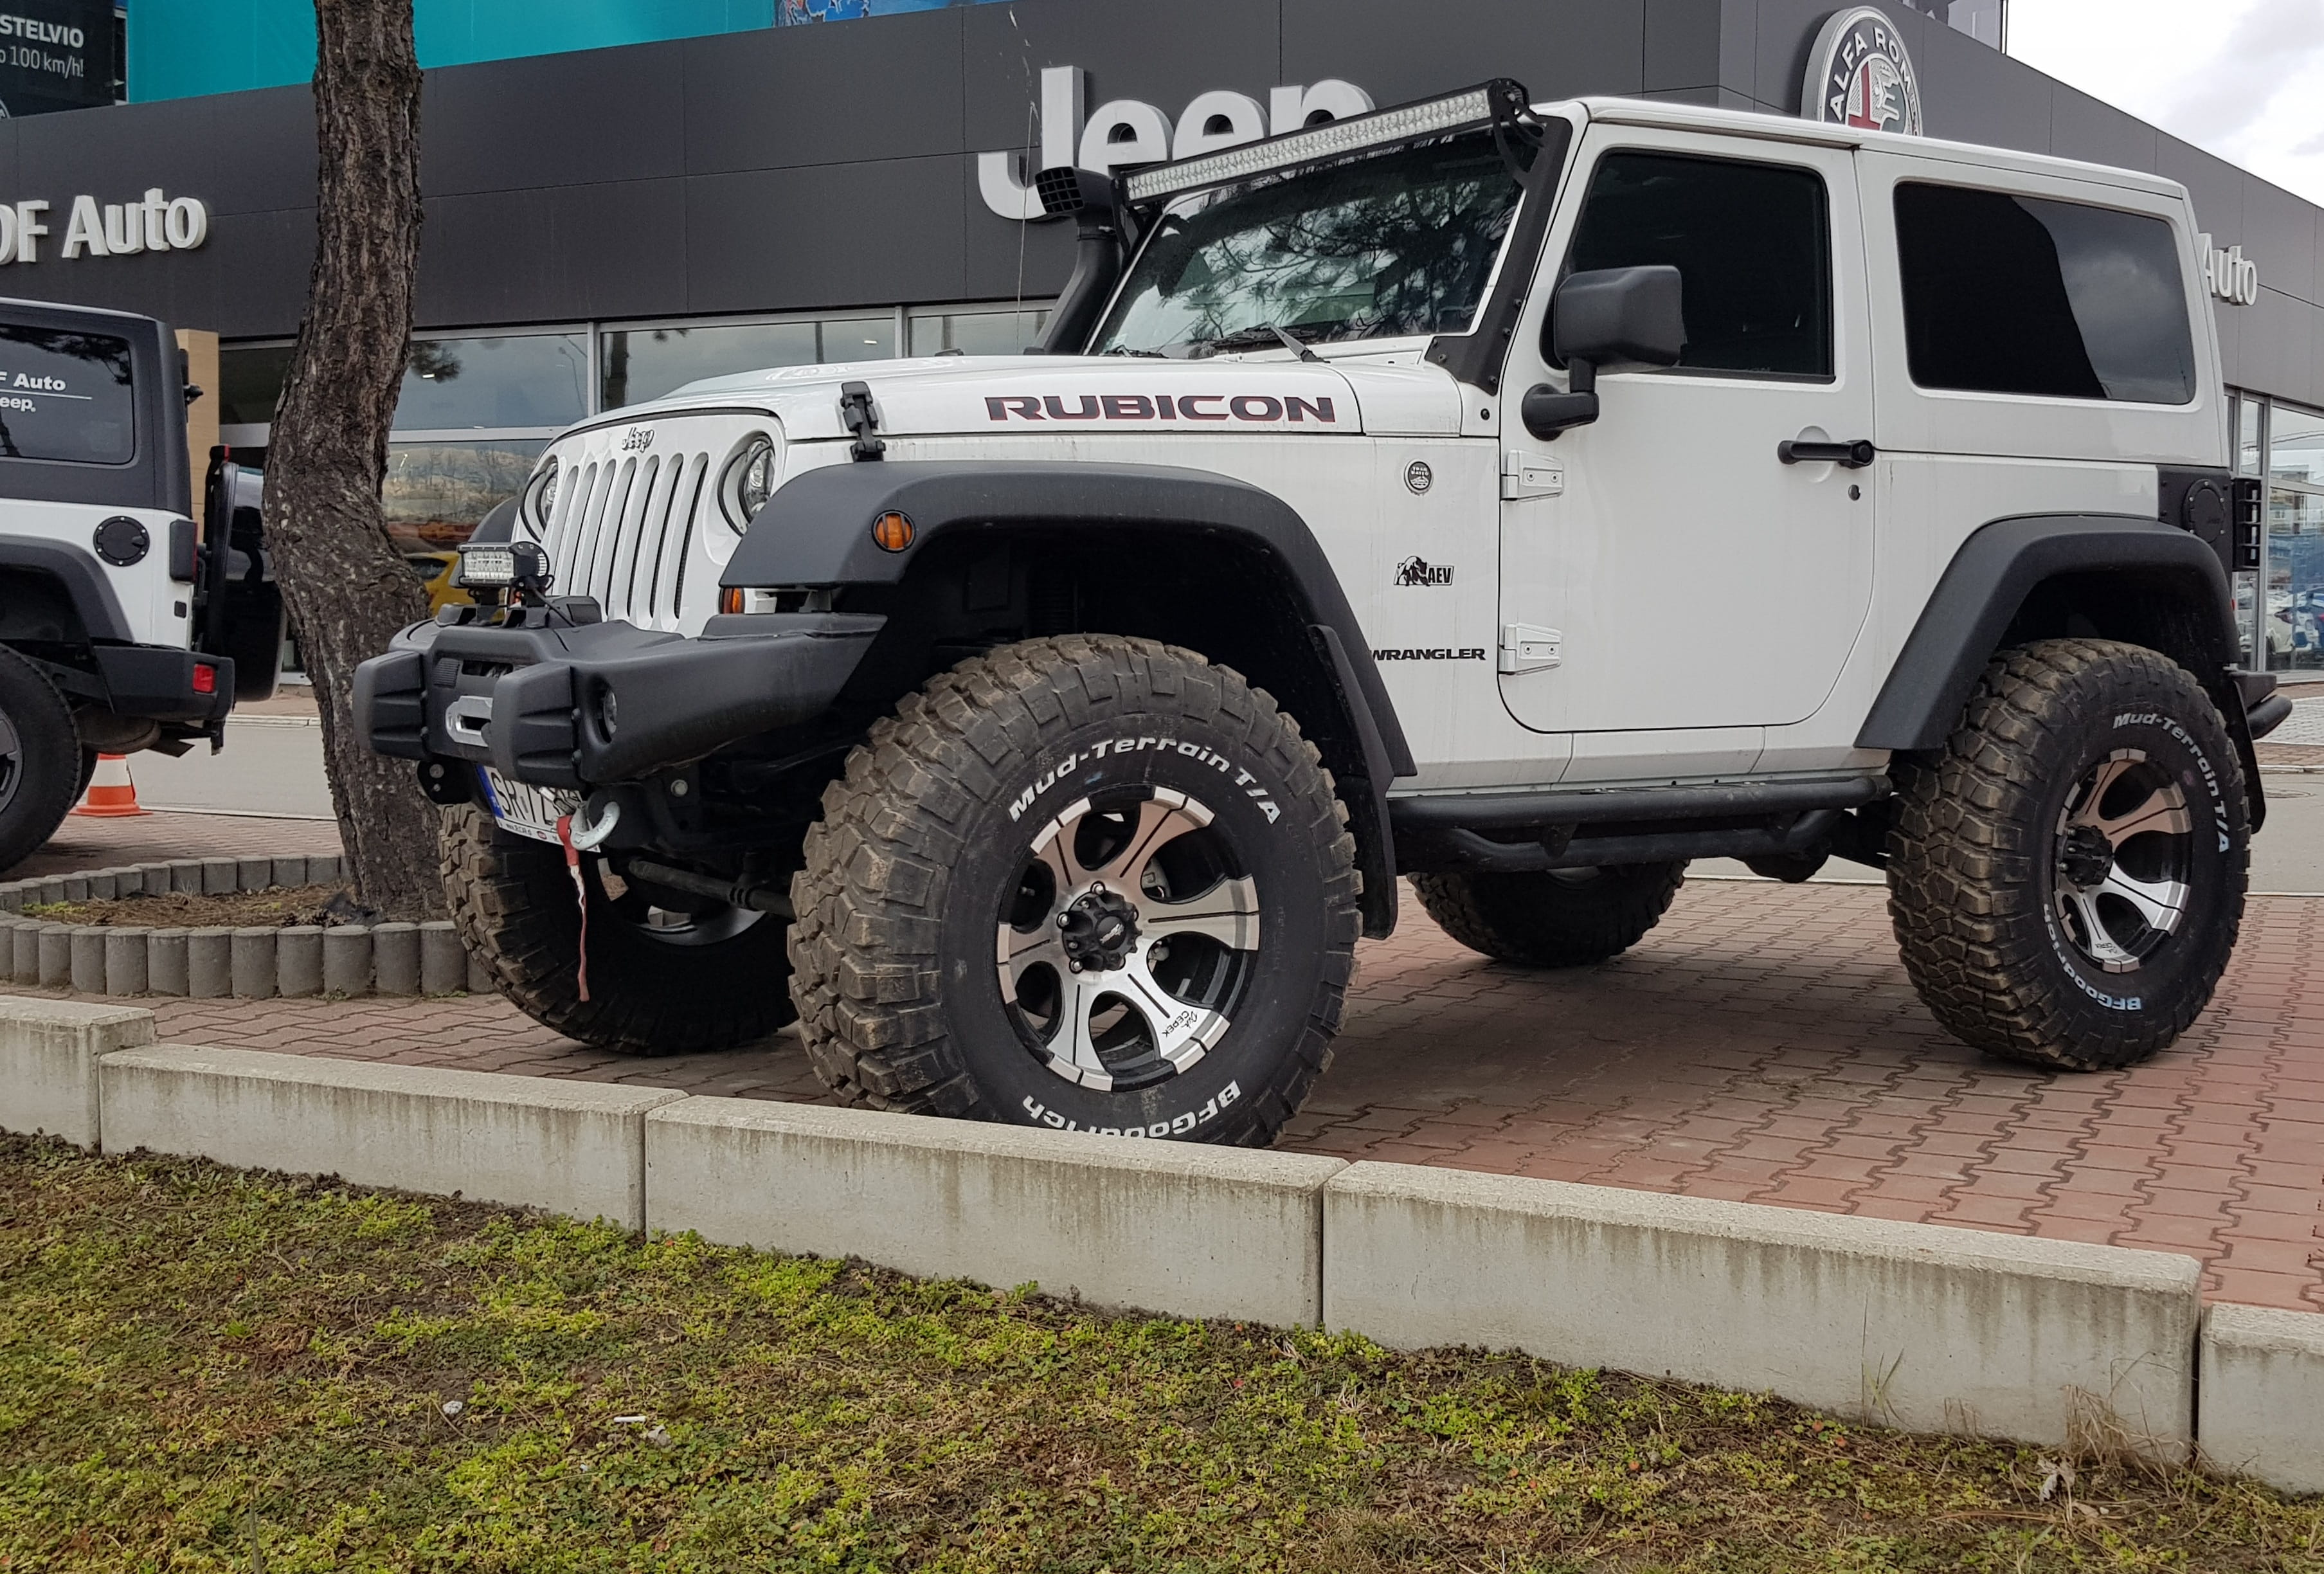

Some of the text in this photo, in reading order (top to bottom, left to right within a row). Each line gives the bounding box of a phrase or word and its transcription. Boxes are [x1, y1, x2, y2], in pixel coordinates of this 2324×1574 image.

[0, 14, 84, 48] STELVIO
[10, 46, 41, 69] 100
[44, 51, 84, 79] km/h!
[1830, 32, 1868, 121] ALFA
[62, 187, 207, 258] Auto
[2197, 232, 2257, 305] Auto
[13, 373, 66, 391] Auto
[984, 395, 1336, 423] RUBICON
[622, 427, 654, 453] Jeep
[1428, 567, 1452, 584] AEV
[1371, 648, 1486, 660] WRANGLER
[1008, 737, 1281, 825] Mud-Terrain T/A
[2112, 712, 2229, 853] Mud-Terrain T/A
[2044, 903, 2142, 1010] BFGoodrich
[1161, 1010, 1189, 1038] CEPEK
